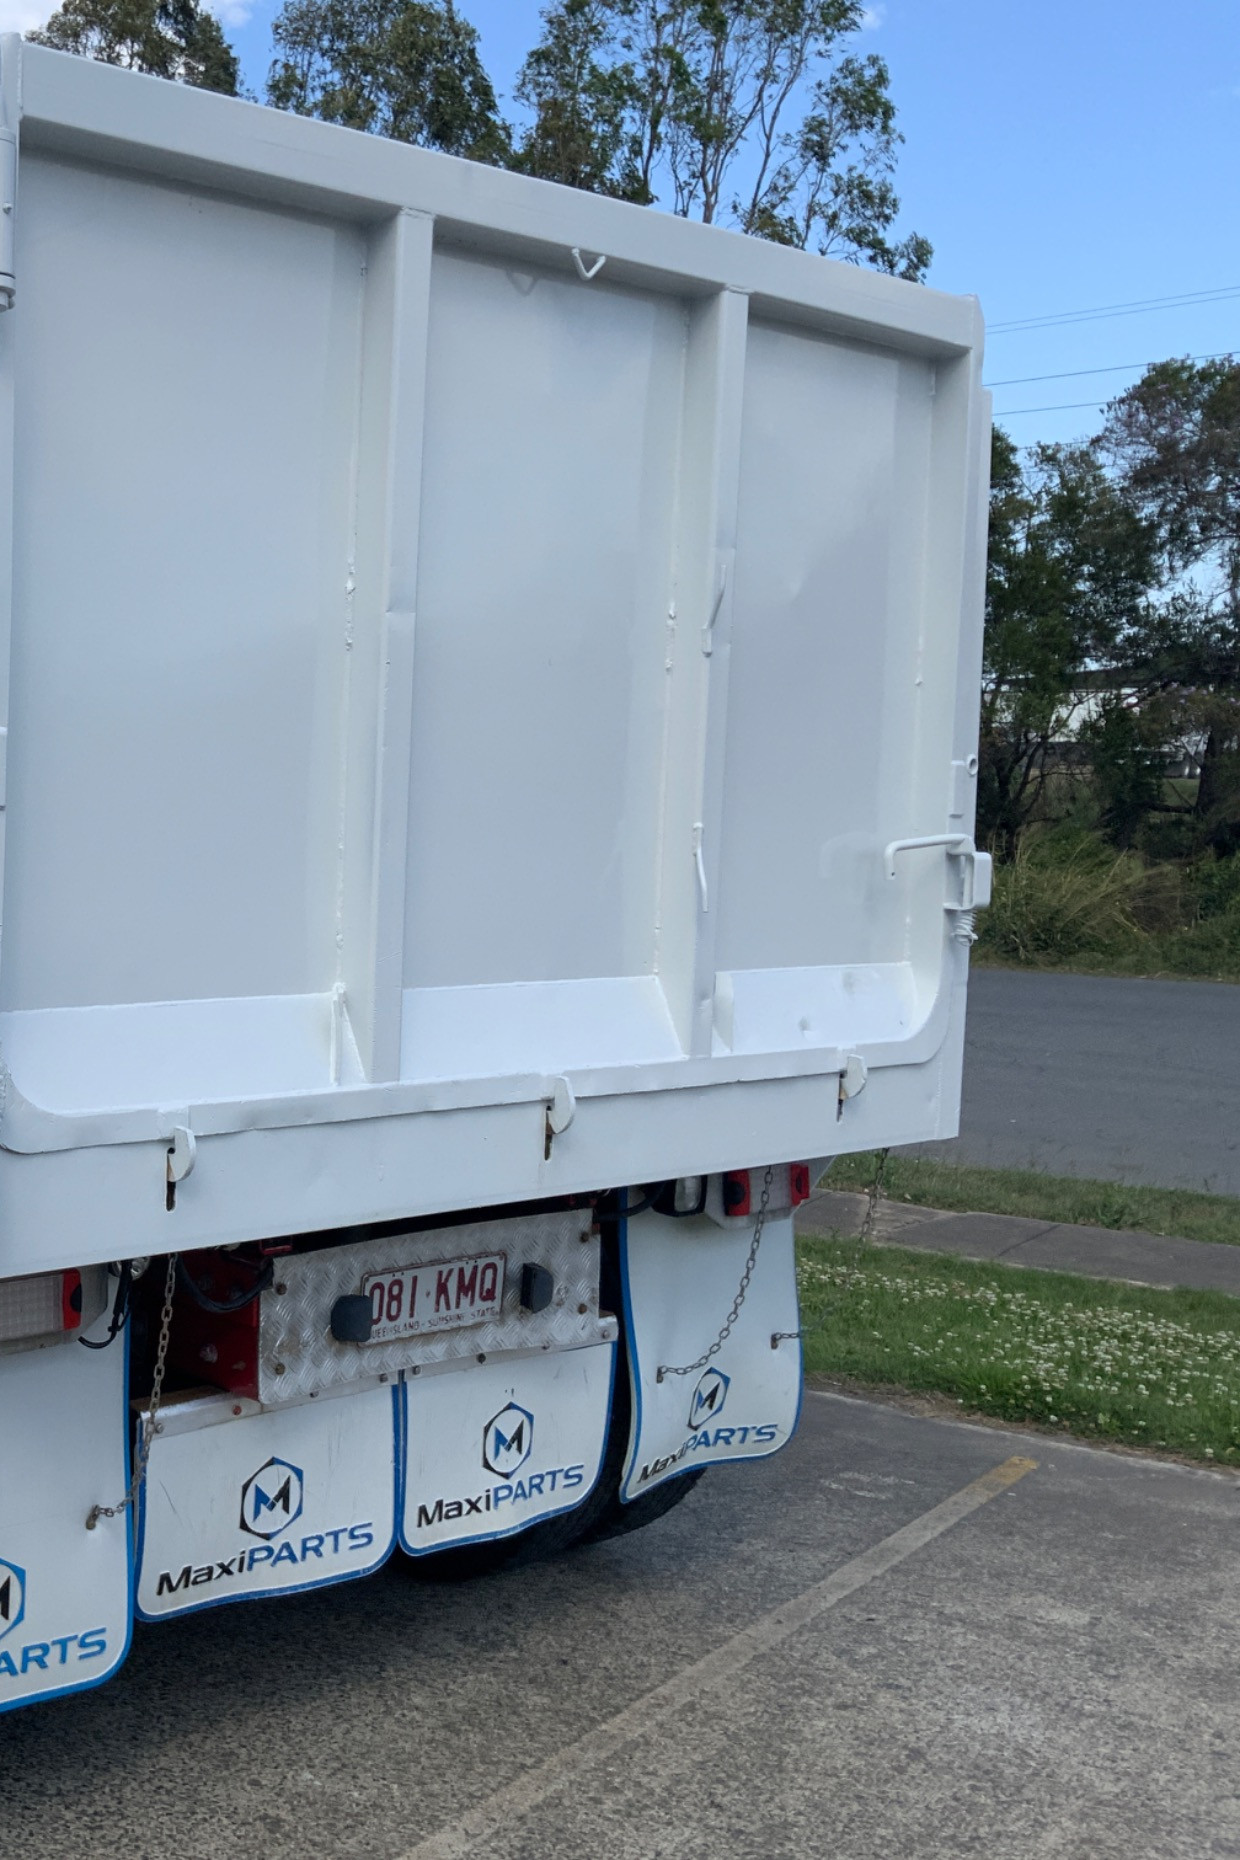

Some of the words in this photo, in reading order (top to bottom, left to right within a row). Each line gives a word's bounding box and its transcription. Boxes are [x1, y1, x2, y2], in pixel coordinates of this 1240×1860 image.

[369, 1276, 418, 1326] 081
[435, 1262, 498, 1312] KMQ
[370, 1320, 420, 1339] UEESLAND
[637, 1424, 778, 1483] MaxiPARTS
[417, 1465, 584, 1527] MaxiPARTS
[156, 1522, 374, 1596] MaxiPARTS
